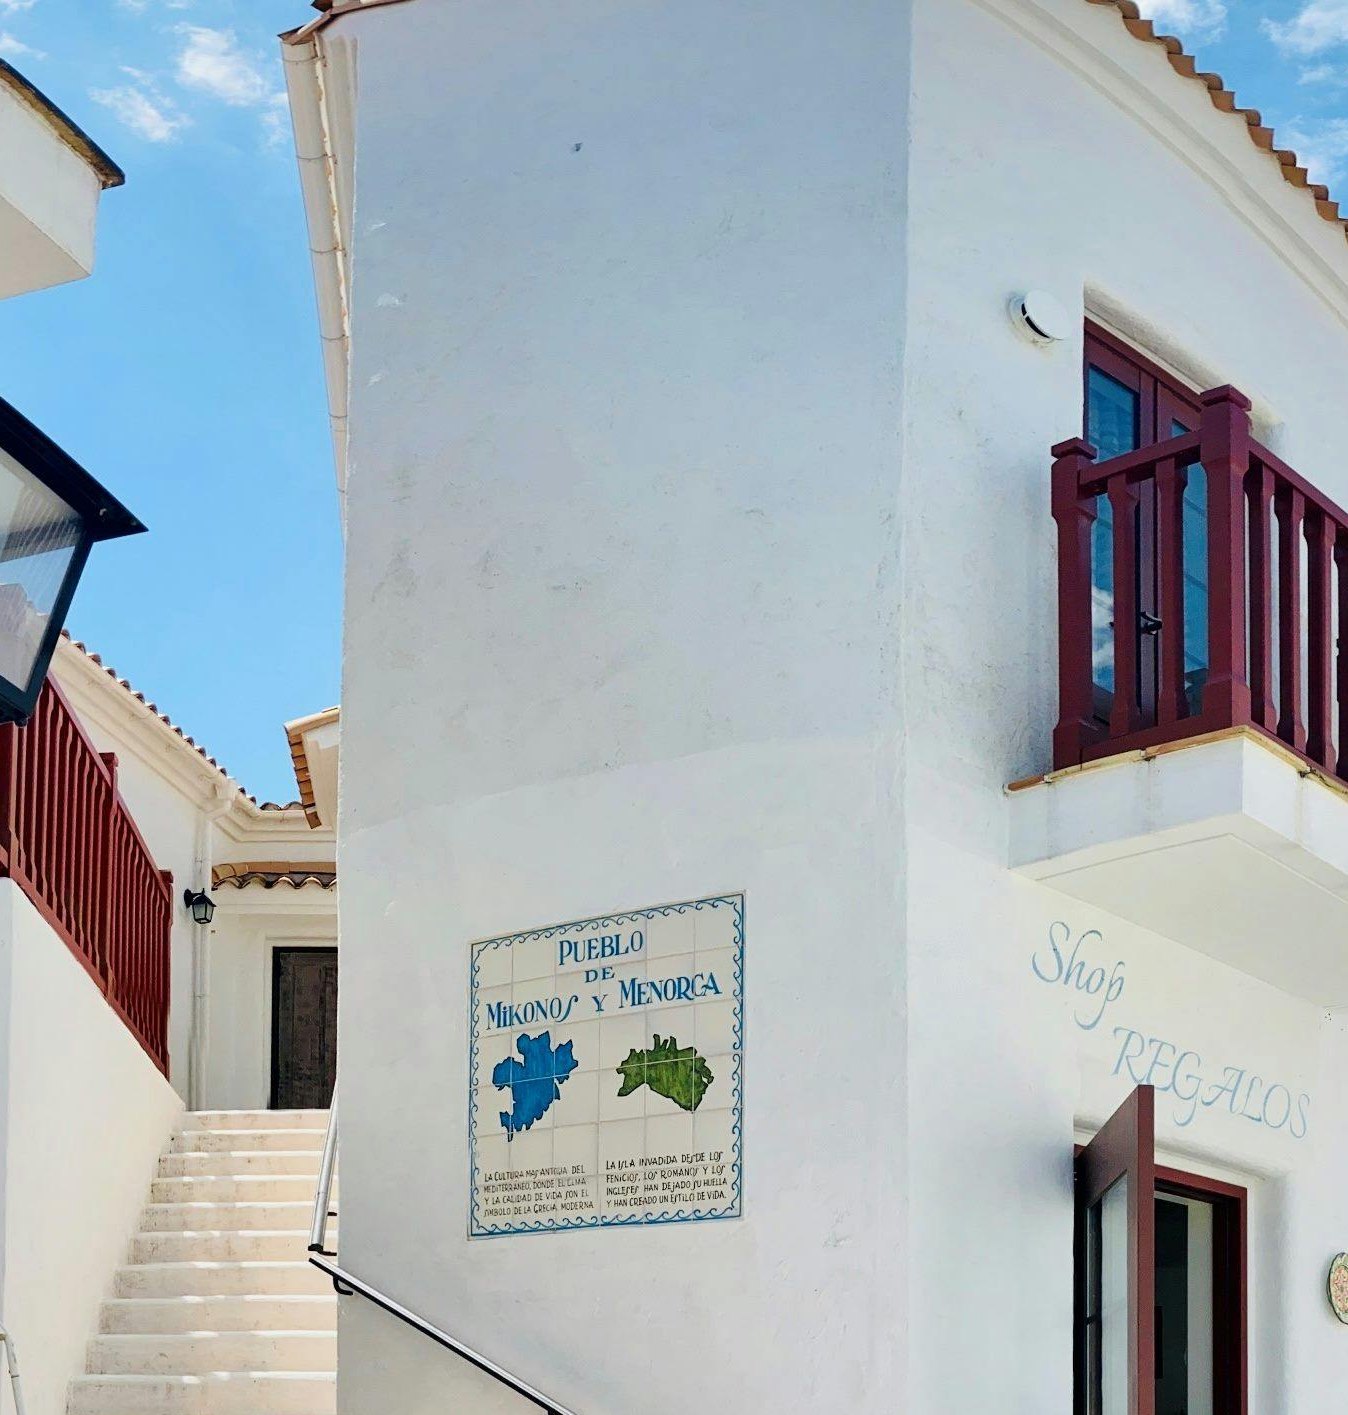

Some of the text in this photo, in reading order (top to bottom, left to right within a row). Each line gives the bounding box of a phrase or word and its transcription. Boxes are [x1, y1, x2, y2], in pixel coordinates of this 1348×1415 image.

[558, 930, 644, 965] PUEBLO
[585, 966, 615, 983] DE
[1032, 920, 1126, 1030] Shop
[591, 994, 608, 1013] Y
[618, 972, 722, 1009] MENORCA
[1111, 1026, 1310, 1139] REGALOS
[606, 1160, 616, 1170] LA
[618, 1159, 636, 1170] ISLA
[681, 1152, 705, 1164] DESDE
[709, 1151, 723, 1162] LOS
[484, 1173, 493, 1182] LA
[494, 1170, 524, 1181] CULTURA
[571, 1165, 585, 1174] DEL
[643, 1171, 657, 1181] LOS
[660, 1167, 699, 1180] ROMANOS
[702, 1166, 709, 1175] Y
[711, 1164, 726, 1175] LOS
[533, 1180, 554, 1190] DONDE
[557, 1179, 566, 1188] EL
[606, 1177, 728, 1197] INGLESES HAN DEJADO SU HUELLA
[492, 1197, 500, 1205] LA
[534, 1192, 544, 1201] DE
[545, 1191, 563, 1200] VIDA
[564, 1190, 578, 1200] SON
[581, 1189, 589, 1198] EL
[606, 1200, 612, 1208] Y
[614, 1198, 628, 1207] HAN
[629, 1195, 657, 1207] CREADO
[659, 1194, 669, 1204] UN
[697, 1192, 705, 1201] DE
[514, 1206, 522, 1215] DE
[523, 1205, 532, 1214] LA
[560, 1201, 594, 1211] MODERNA
